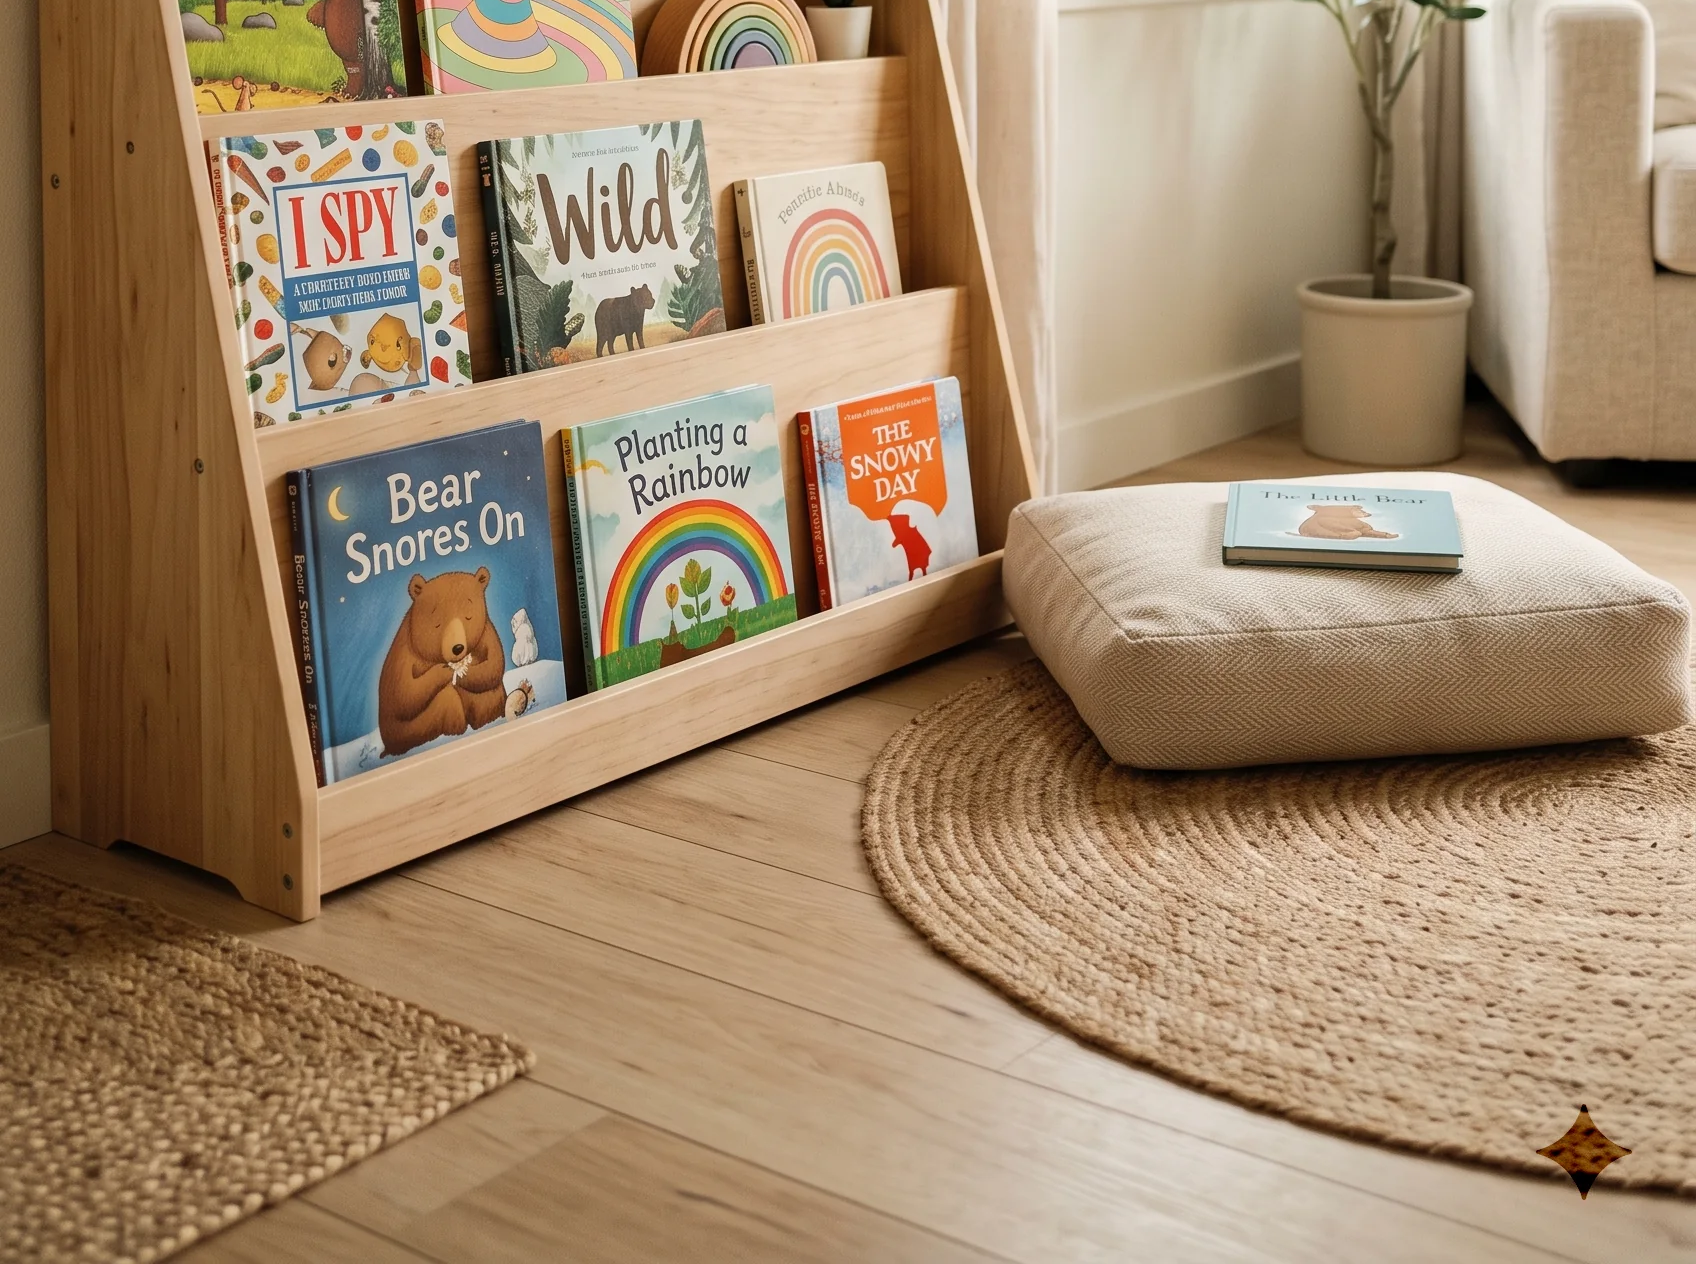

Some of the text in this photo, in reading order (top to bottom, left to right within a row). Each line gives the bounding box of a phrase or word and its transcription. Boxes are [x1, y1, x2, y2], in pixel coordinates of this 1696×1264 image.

[288, 196, 311, 269] I
[320, 186, 398, 267] SPY
[536, 147, 678, 265] Wild
[614, 417, 724, 472] Planting
[733, 424, 747, 446] a
[850, 436, 937, 480] SNOWY
[872, 419, 912, 445] THE
[386, 469, 481, 524] Bear
[628, 453, 751, 515] Rainbow
[873, 468, 920, 502] DAY
[345, 501, 525, 584] Snores On
